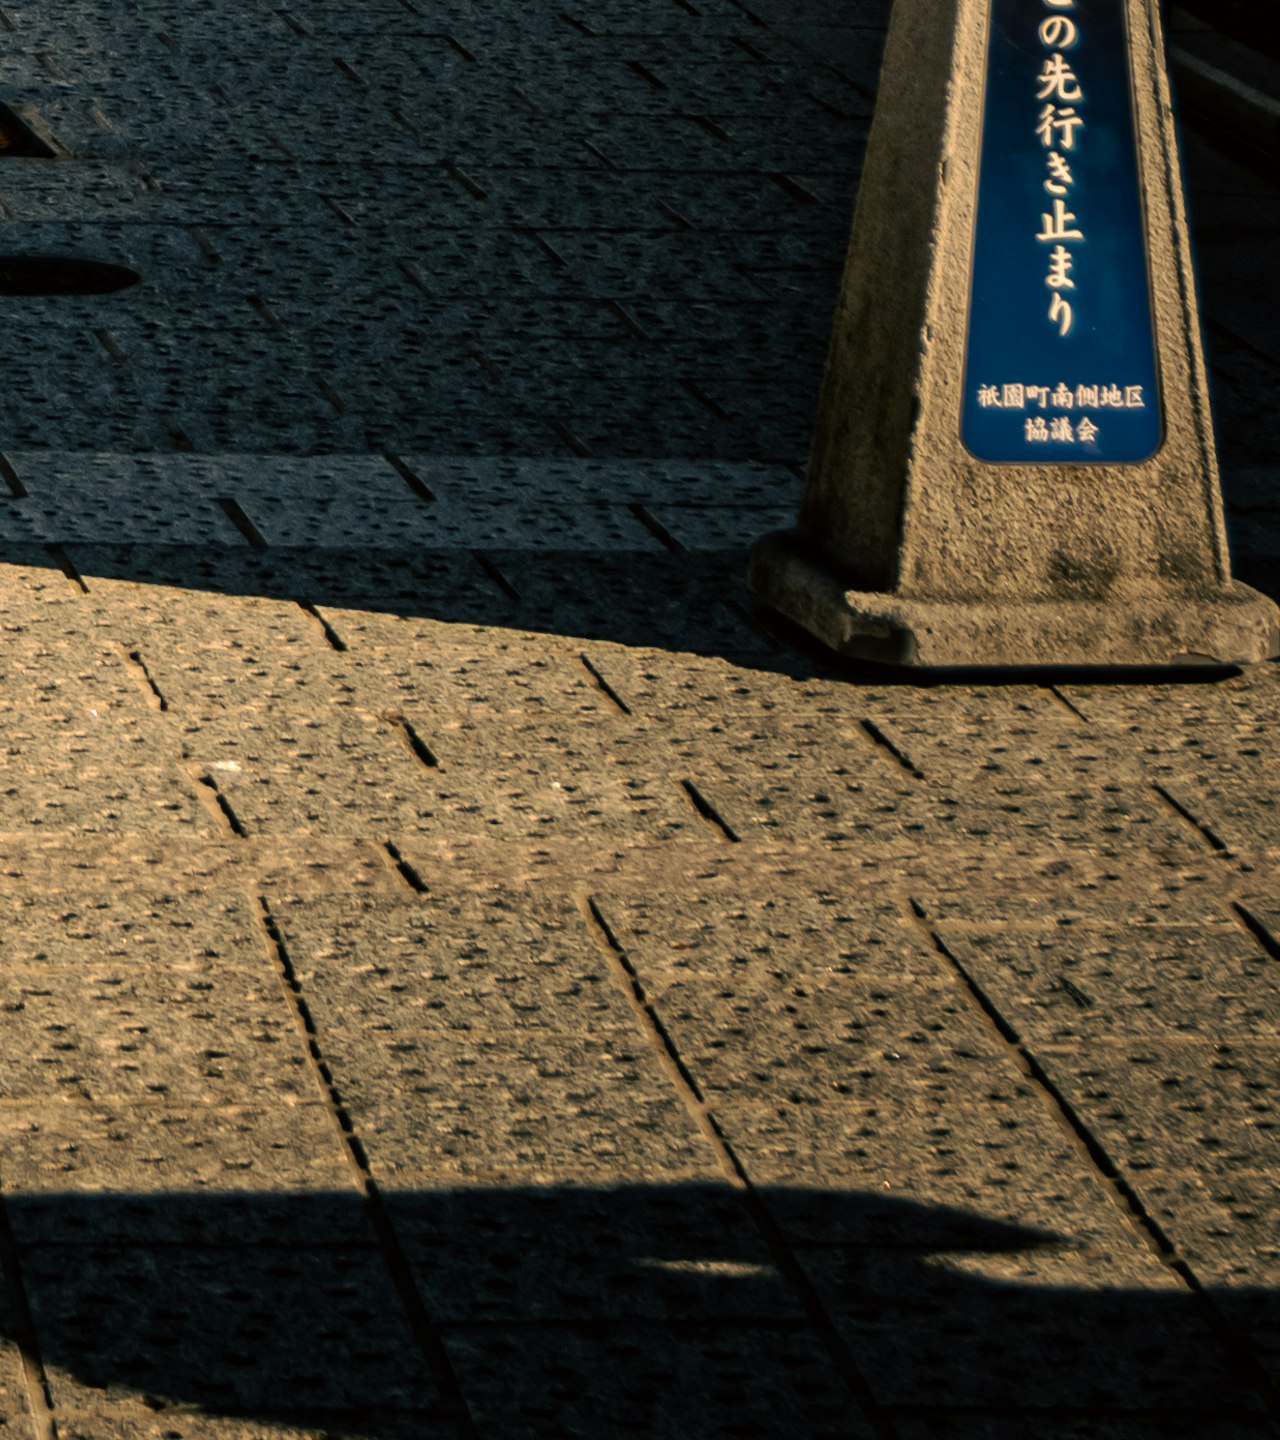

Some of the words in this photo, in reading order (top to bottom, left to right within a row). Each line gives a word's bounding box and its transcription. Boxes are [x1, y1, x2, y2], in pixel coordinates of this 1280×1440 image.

[977, 381, 1146, 410] 祇園町南側地区
[1023, 415, 1100, 444] 協議会
